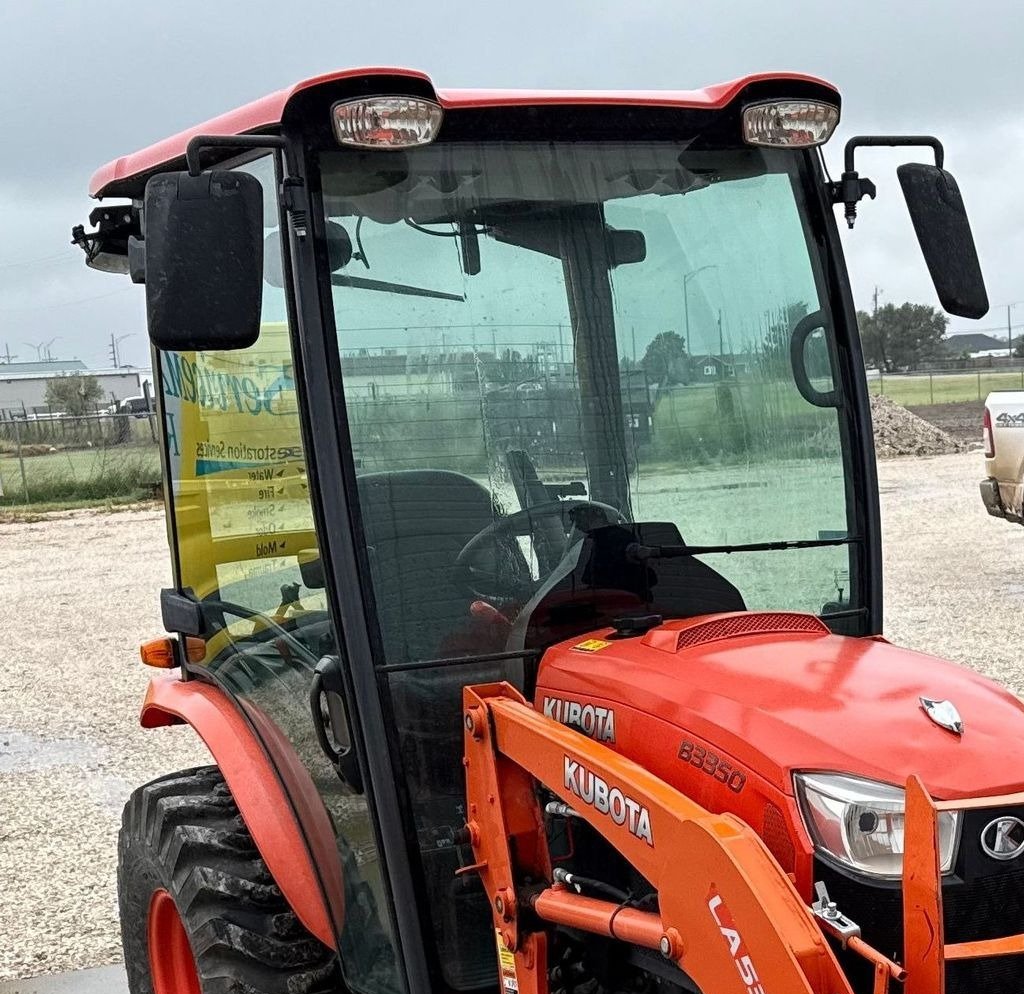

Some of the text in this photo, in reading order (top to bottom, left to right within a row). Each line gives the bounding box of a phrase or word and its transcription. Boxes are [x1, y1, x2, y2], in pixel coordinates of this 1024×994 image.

[543, 696, 617, 744] KUBOTA
[677, 738, 747, 794] B3350
[563, 753, 655, 849] KUBOTA
